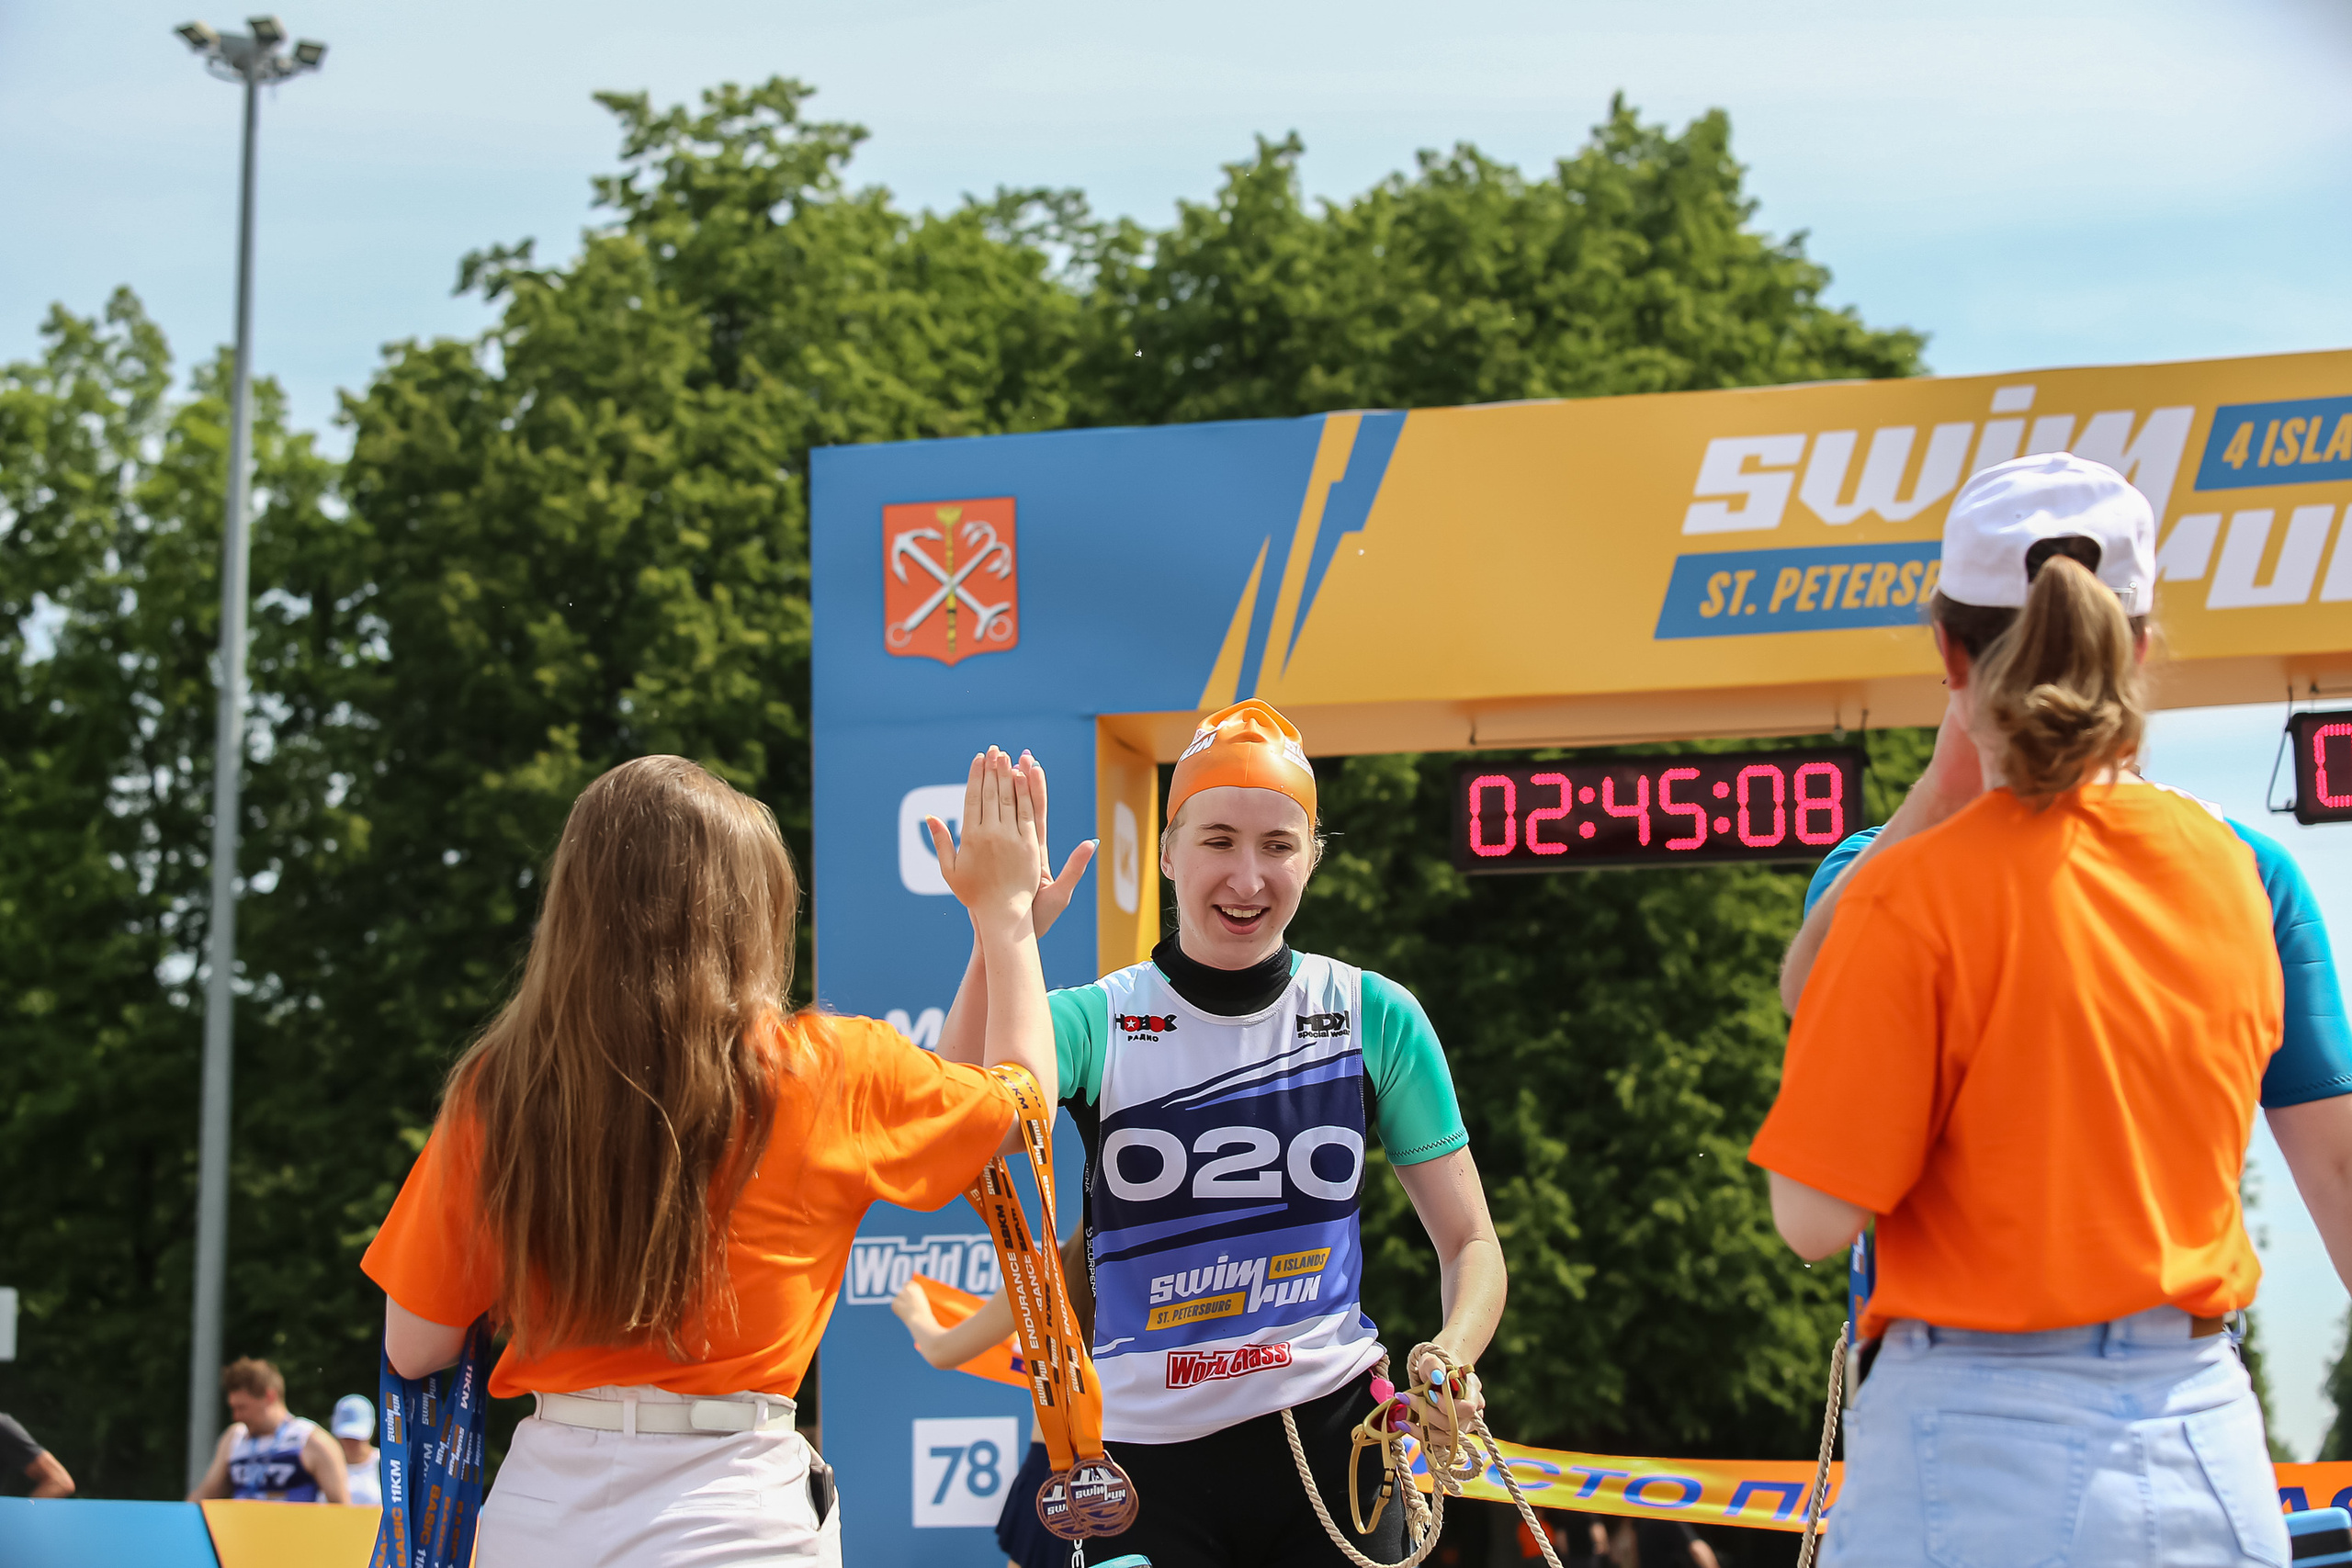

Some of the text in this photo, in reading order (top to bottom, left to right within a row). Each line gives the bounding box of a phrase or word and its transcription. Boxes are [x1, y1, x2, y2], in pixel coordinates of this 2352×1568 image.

[2222, 422, 2254, 469] 4
[1700, 569, 1757, 618] ST.
[1469, 761, 1844, 857] 02:45:08
[1102, 1126, 1364, 1201] 020
[1274, 1253, 1326, 1272] 4 ISLANDS
[1007, 1252, 1039, 1349] ENDURANCE
[1157, 1299, 1232, 1325] ST. PETERSBURG
[390, 1459, 403, 1503] 11KM
[930, 1439, 1001, 1506] 78
[391, 1506, 407, 1567] BASIC
